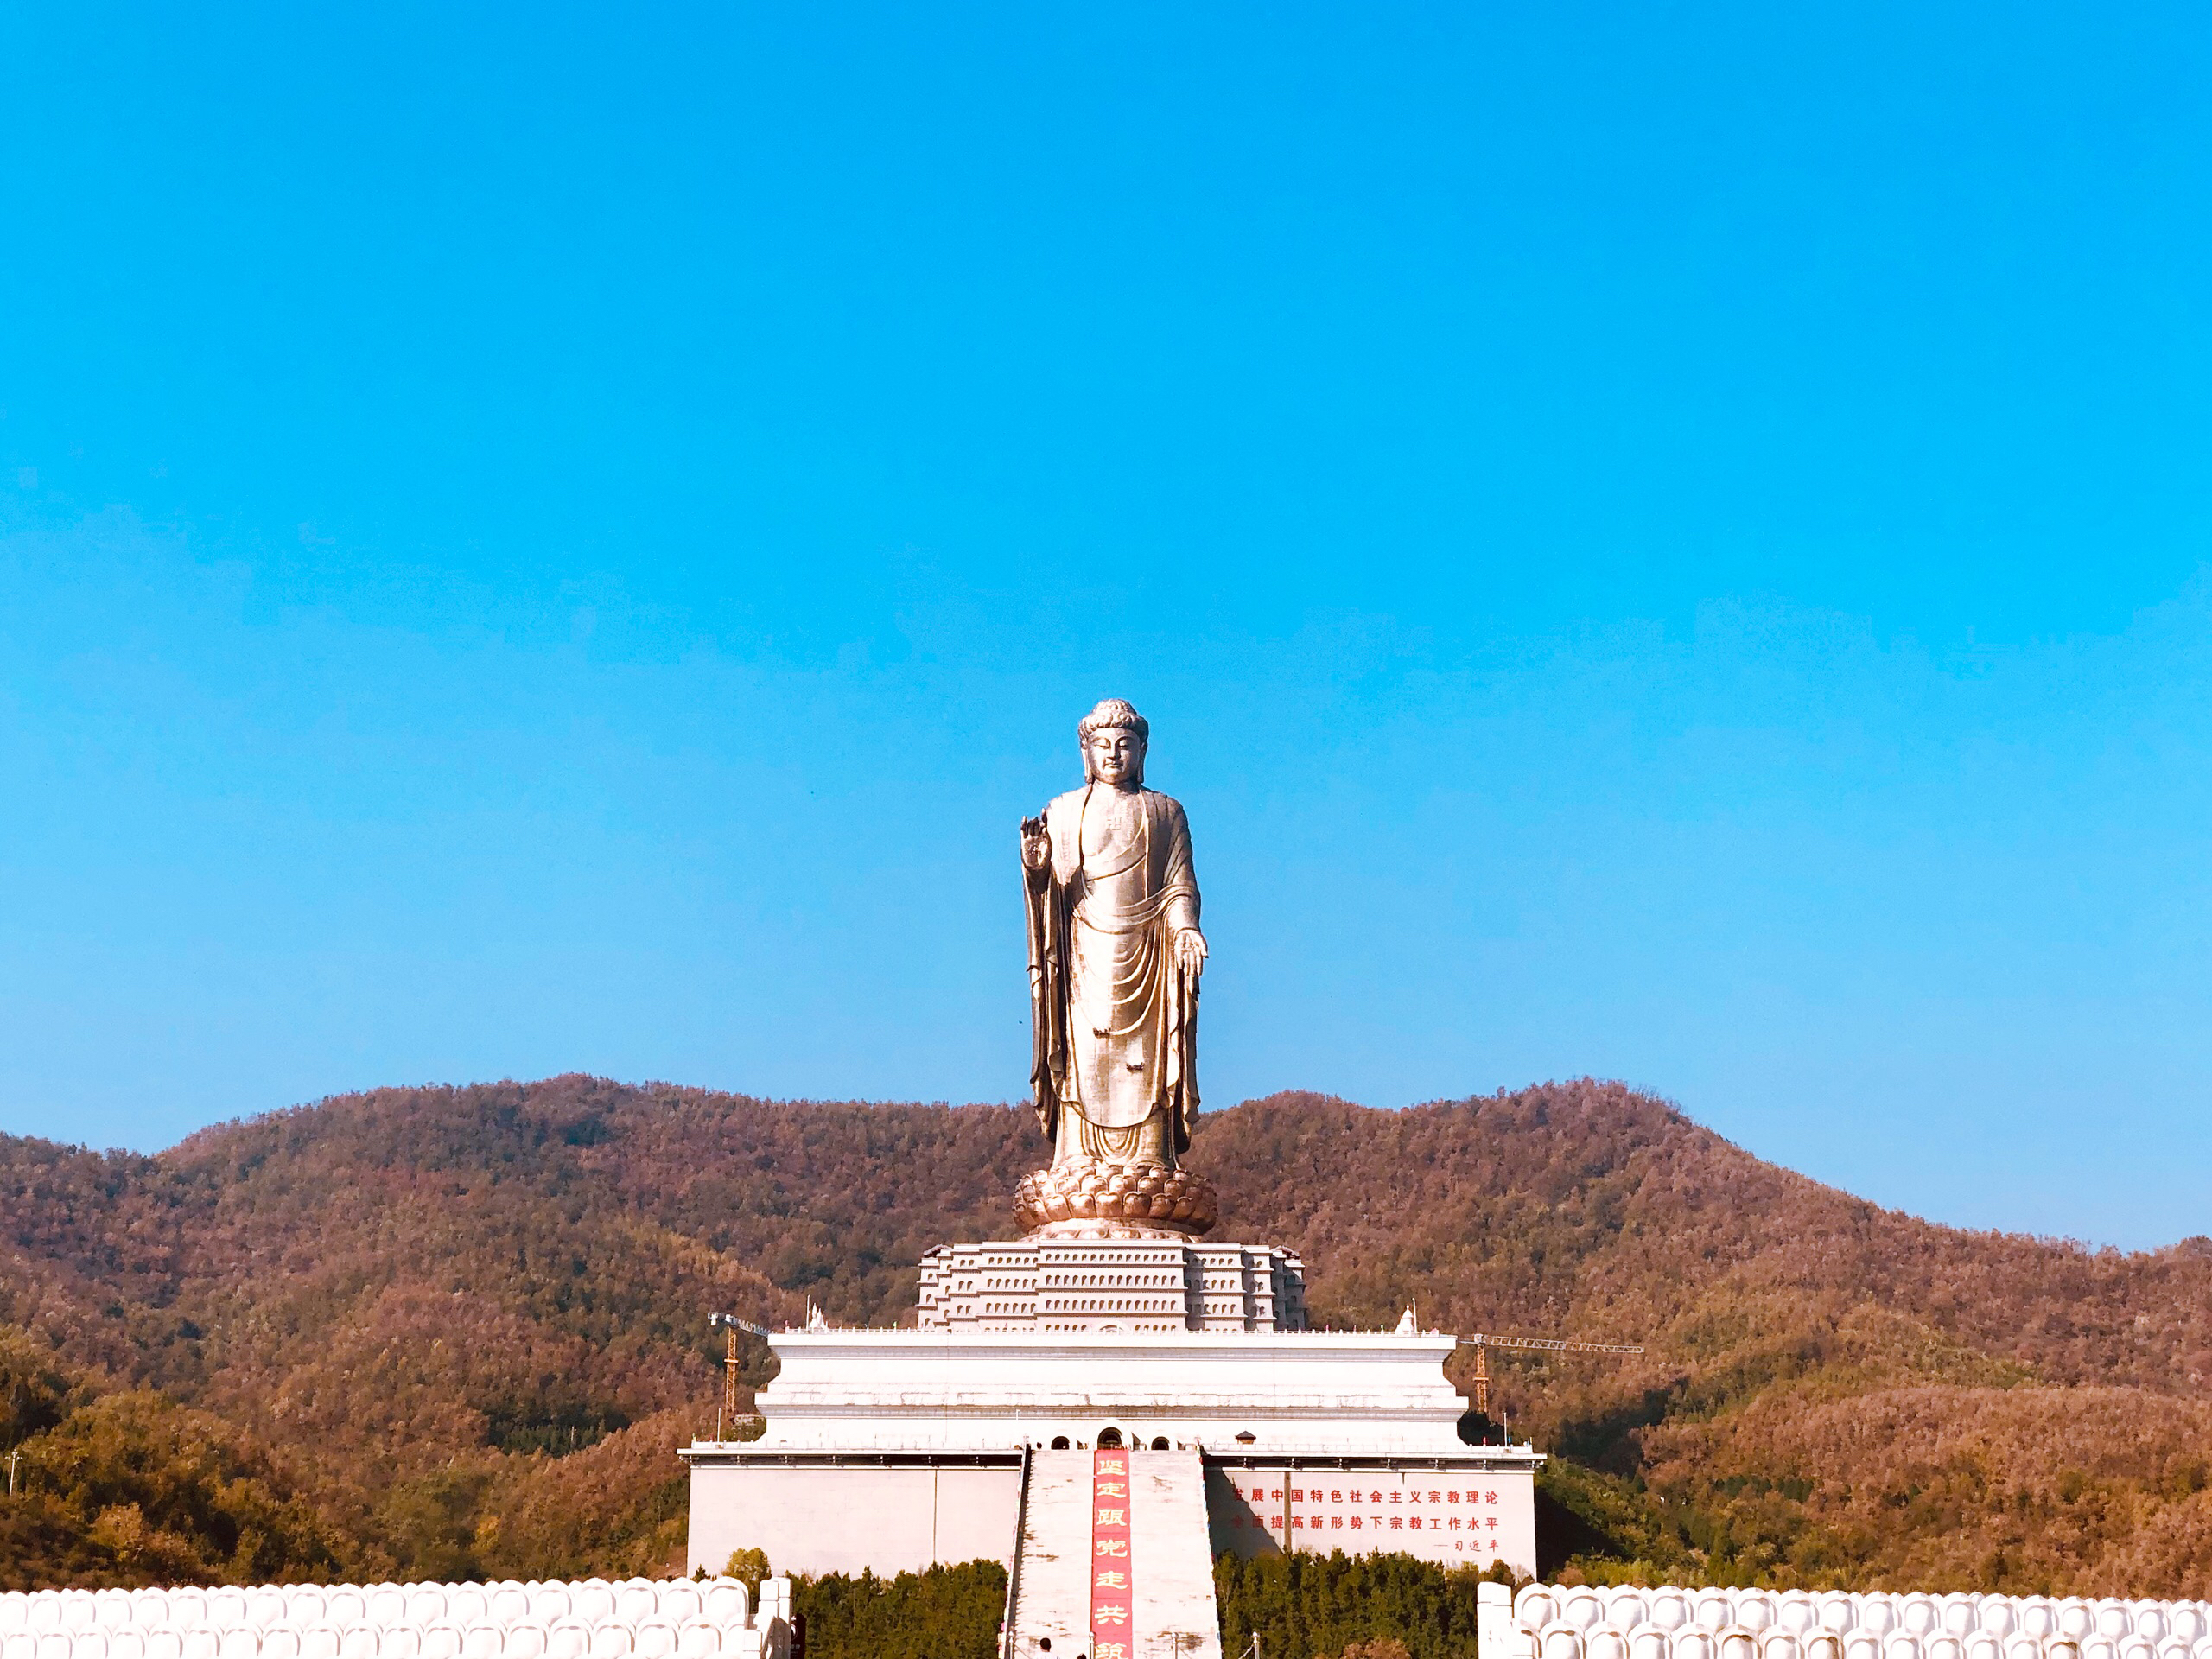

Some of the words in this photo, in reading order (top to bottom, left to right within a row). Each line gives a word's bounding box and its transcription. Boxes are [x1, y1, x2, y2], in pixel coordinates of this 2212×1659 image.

[1233, 1488, 1499, 1505] 发展中国特色社会主义宗教理论
[1231, 1515, 1499, 1531] 全面提高新形势下宗教工作水平
